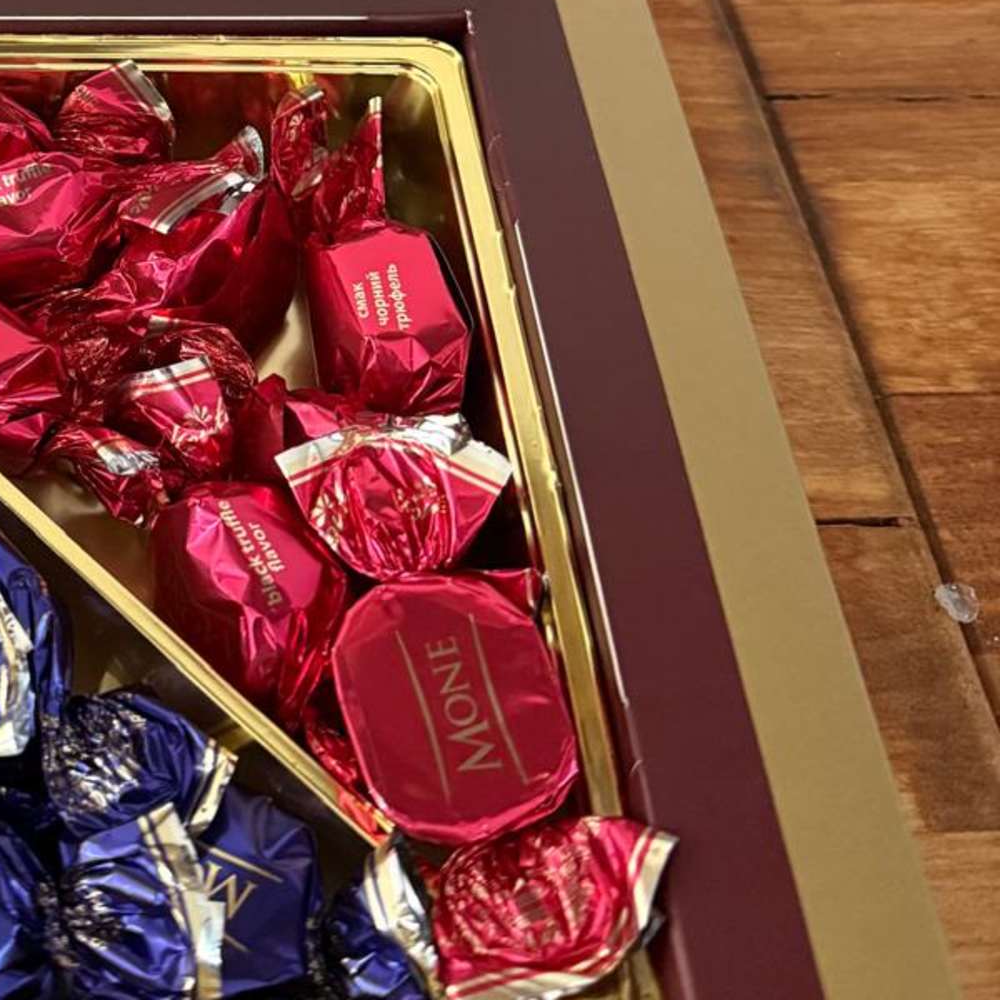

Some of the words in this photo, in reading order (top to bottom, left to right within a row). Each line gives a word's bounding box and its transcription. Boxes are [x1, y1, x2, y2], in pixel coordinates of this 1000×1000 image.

[352, 281, 369, 318] смак
[365, 271, 390, 326] чорний
[387, 263, 413, 331] трюфель
[218, 499, 256, 555] truffle
[247, 521, 286, 573] flavor
[249, 554, 283, 606] black
[424, 635, 504, 772] MONE
